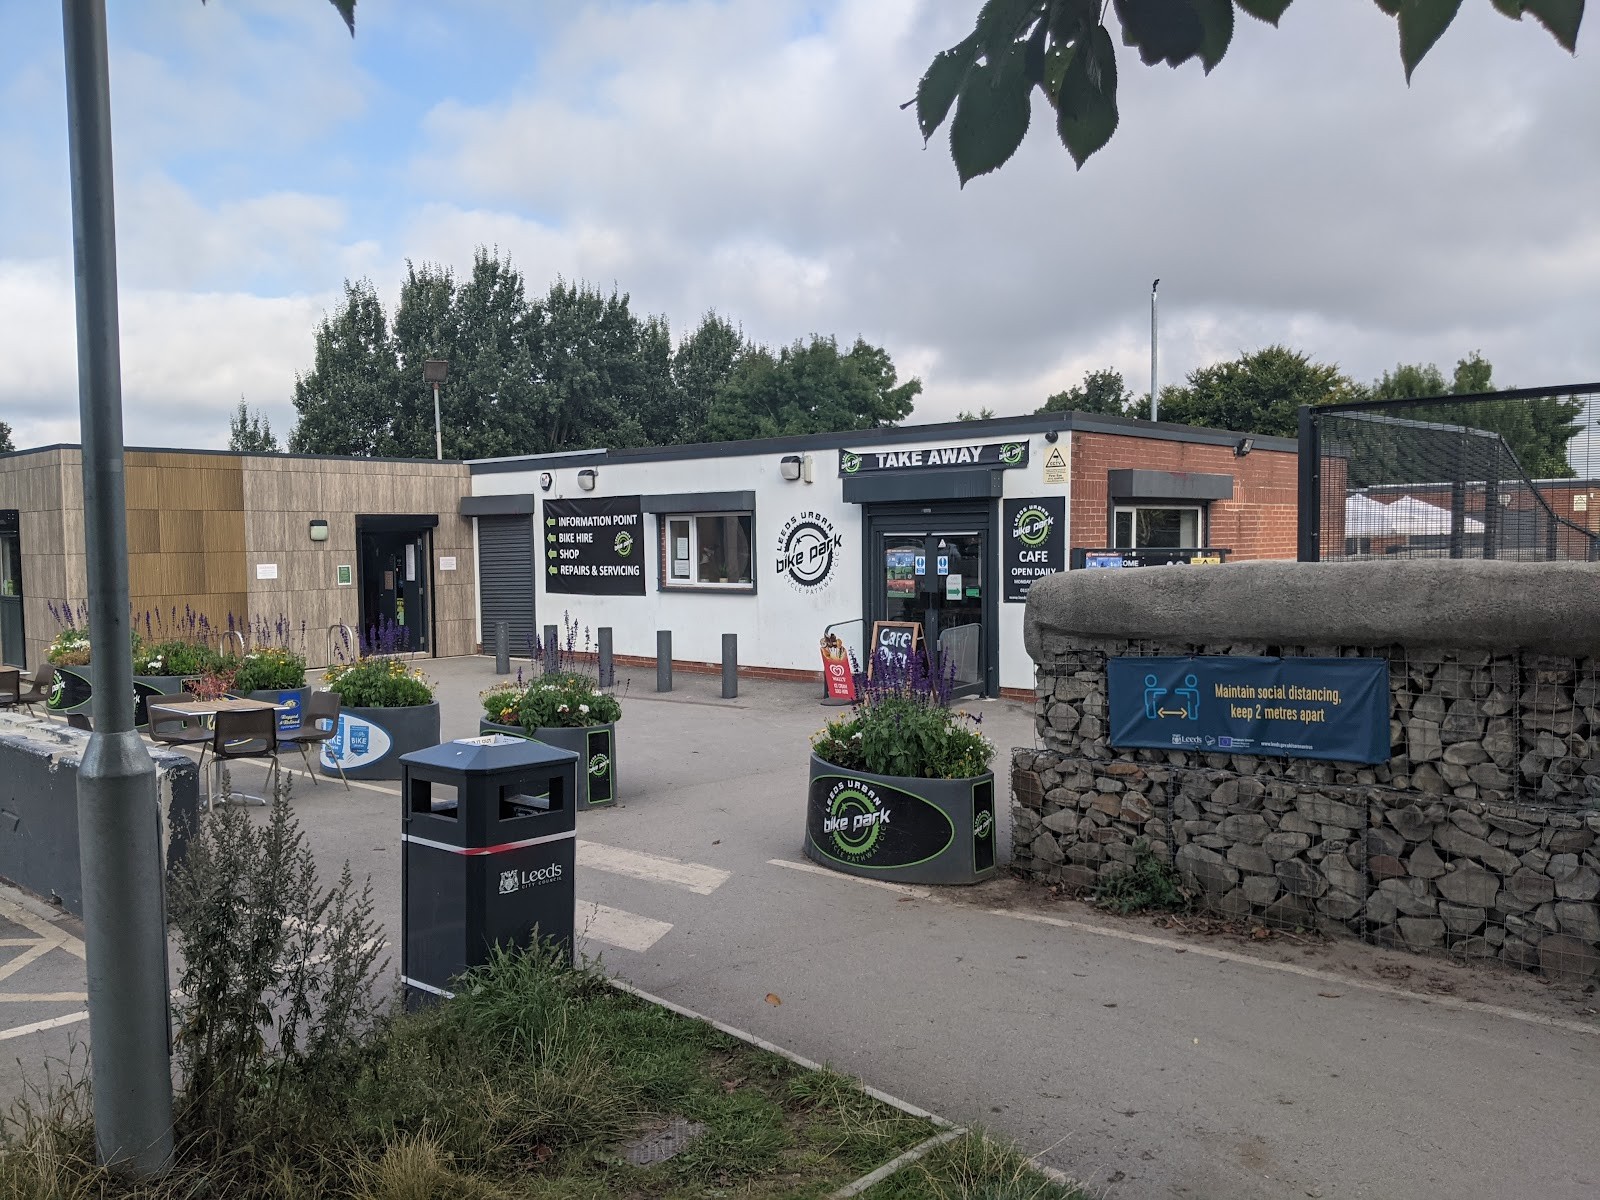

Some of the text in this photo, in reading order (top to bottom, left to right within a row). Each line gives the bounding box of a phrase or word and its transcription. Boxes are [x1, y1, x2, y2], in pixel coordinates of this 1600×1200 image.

[876, 450, 923, 468] TAKE
[927, 446, 983, 465] AWAY
[558, 514, 638, 527] INFORMATION POINT
[1014, 504, 1049, 526] LEEDS URBAN
[558, 533, 594, 543] BIKE HIRE
[776, 512, 834, 551] LEEDS URBAN
[1012, 516, 1054, 538] bike park
[560, 549, 580, 559] SHOP
[776, 533, 842, 574] bike park
[1018, 550, 1048, 562] CAFE
[560, 565, 640, 576] REPAIRS & SERVICING
[1011, 568, 1056, 576] OPEN DAILY
[784, 574, 802, 594] CYCLE
[806, 572, 835, 595] PATHWAY
[1214, 683, 1342, 706] Maintain social distancing,
[1230, 704, 1325, 725] keep 2 metres apart
[826, 780, 882, 812] LEEDS URBAN
[823, 807, 892, 834] bike park
[828, 836, 844, 858] CYCLE
[847, 844, 880, 862] PATHWAY
[522, 862, 562, 884] Leeds
[538, 876, 562, 886] COUNCIL
